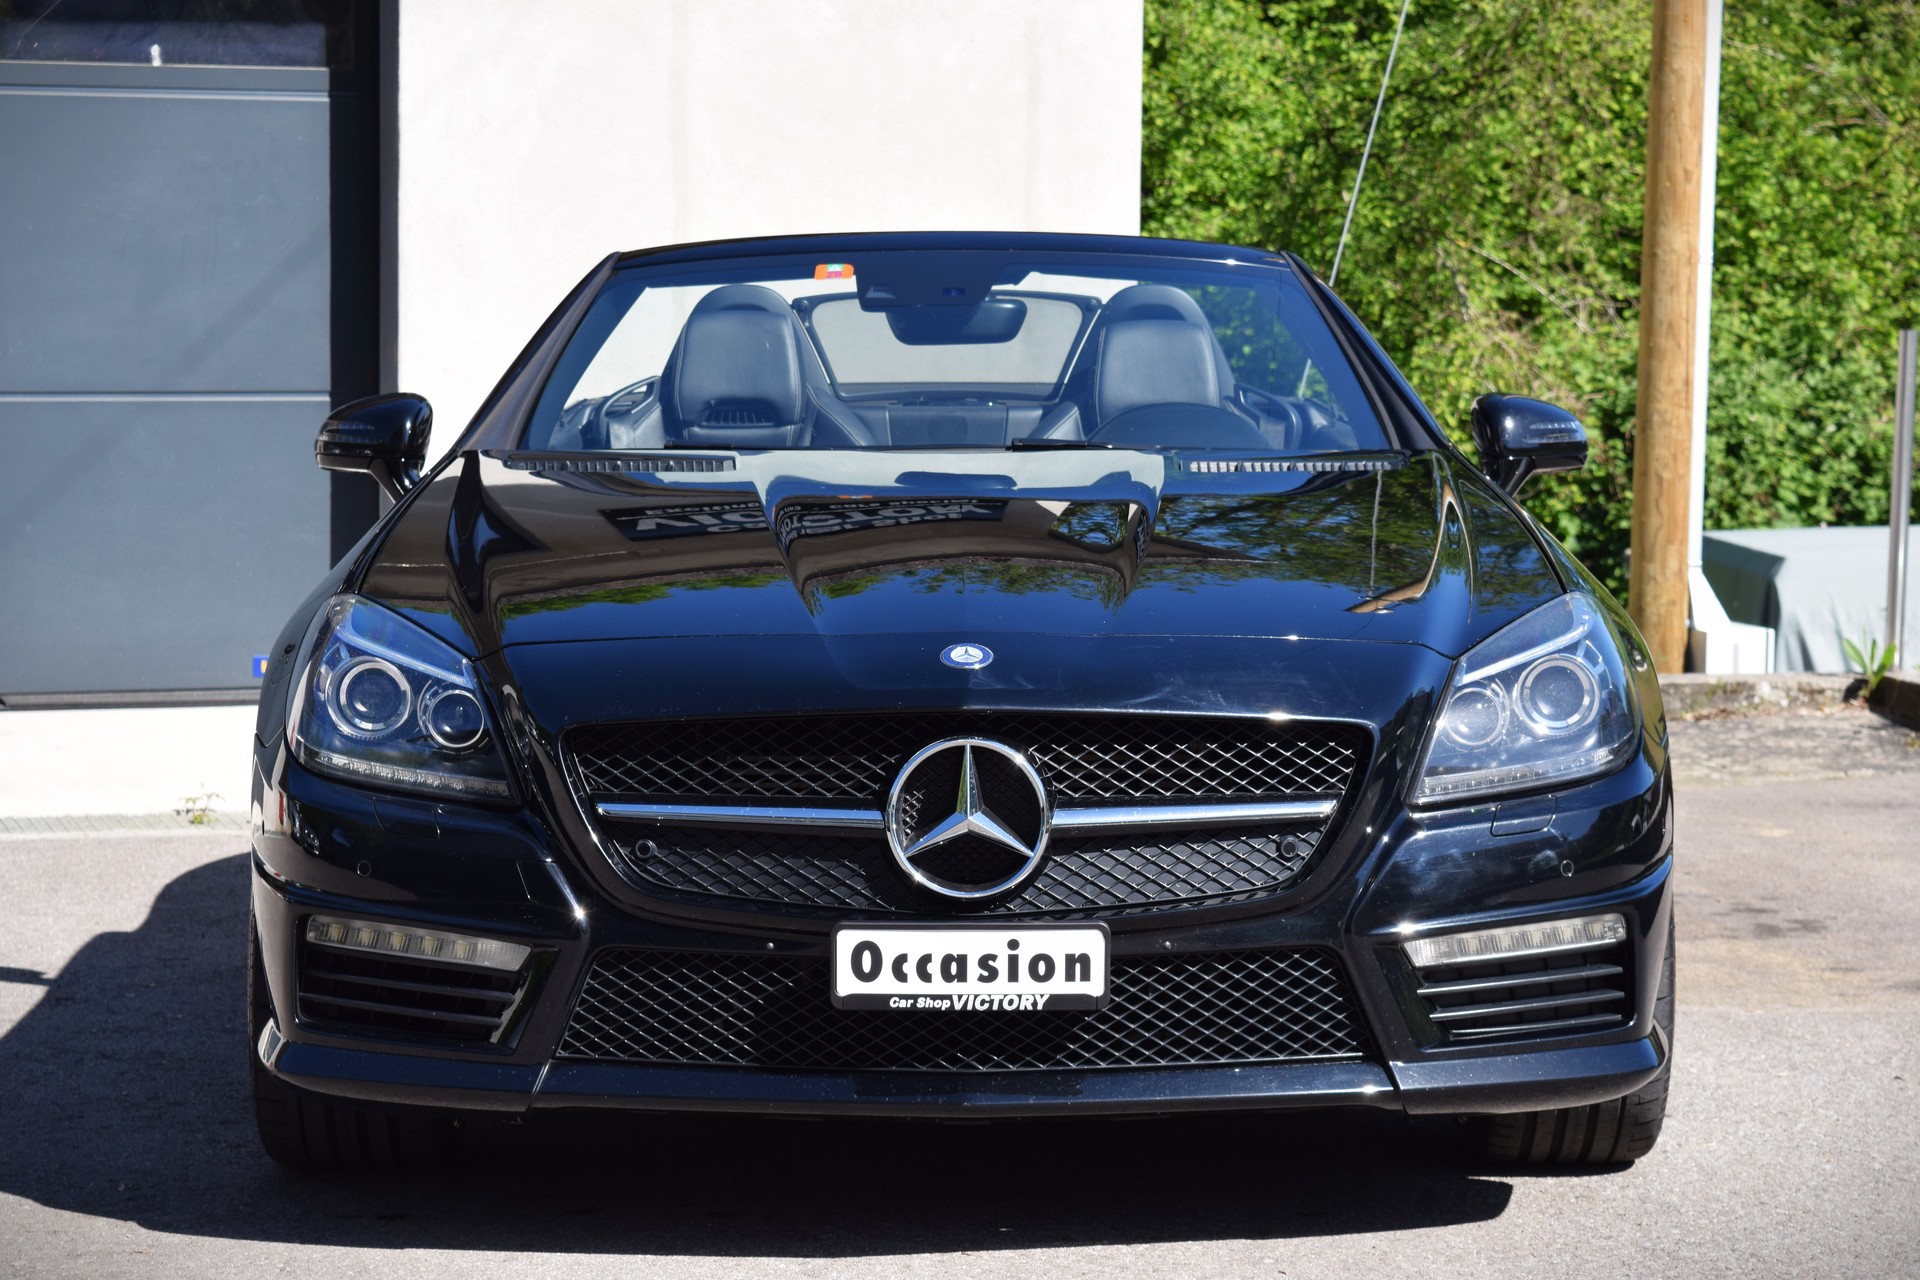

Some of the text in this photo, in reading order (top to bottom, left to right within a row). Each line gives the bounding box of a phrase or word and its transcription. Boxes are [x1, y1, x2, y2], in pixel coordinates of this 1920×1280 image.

[850, 938, 1092, 984] Occasion
[889, 993, 1050, 1011] Car Shop VICTORY
